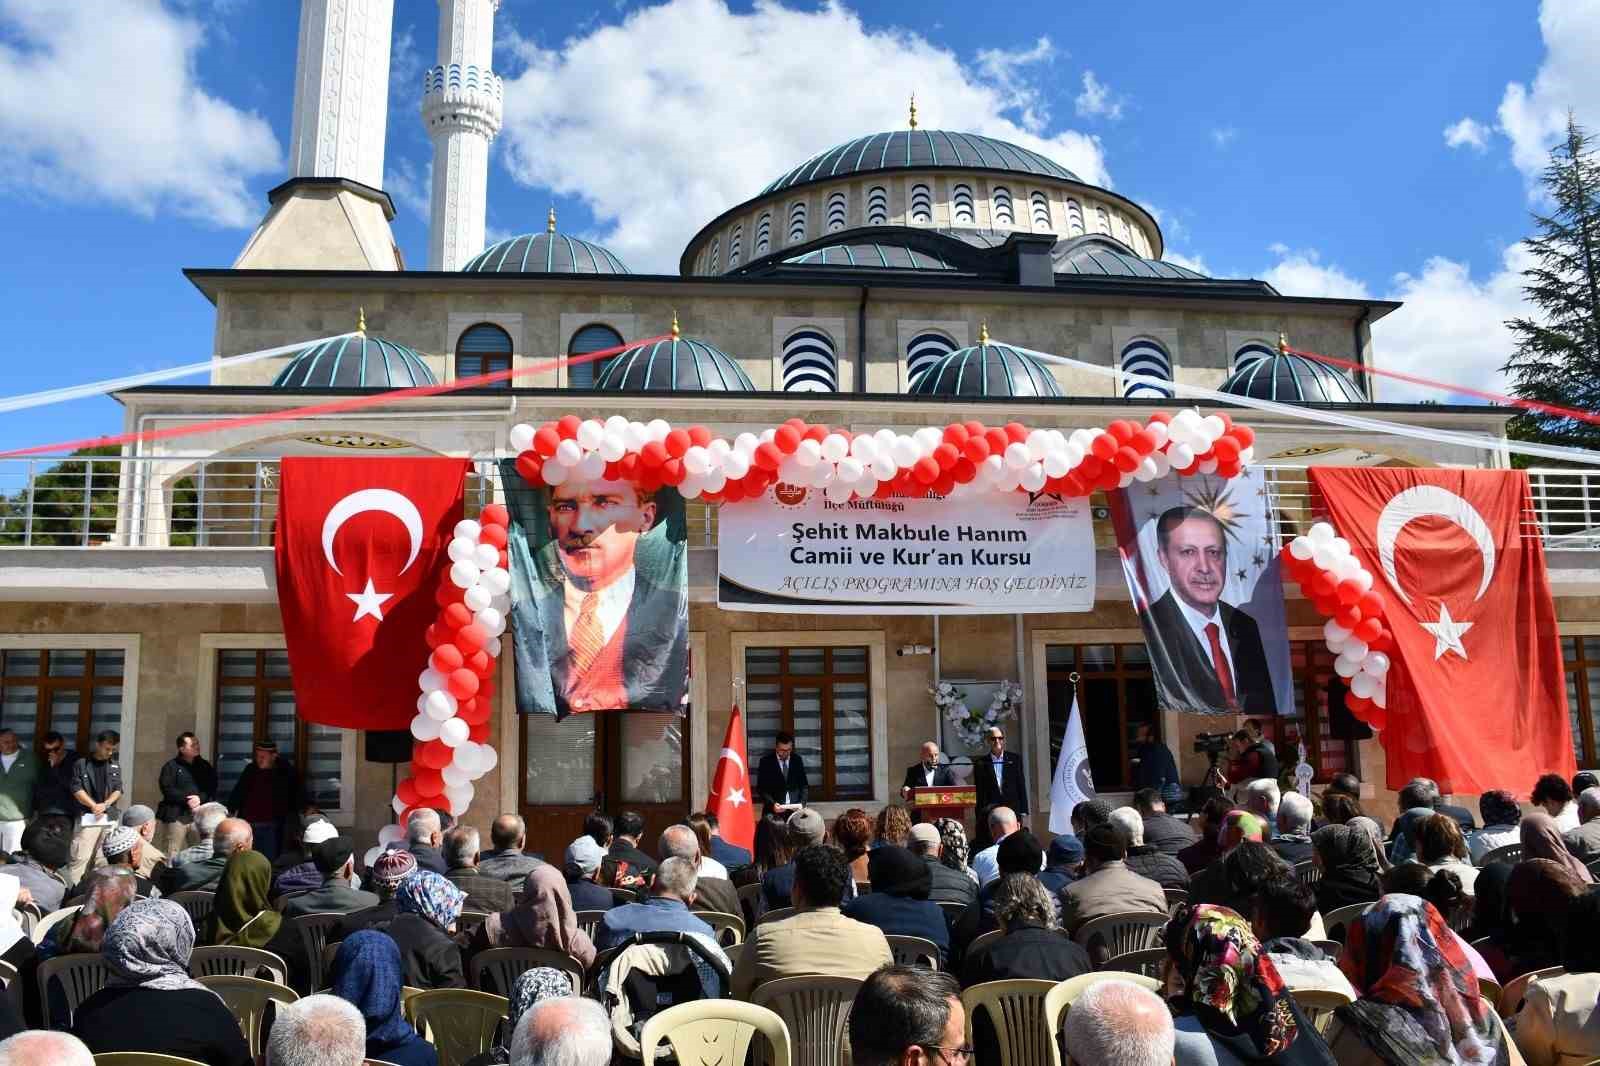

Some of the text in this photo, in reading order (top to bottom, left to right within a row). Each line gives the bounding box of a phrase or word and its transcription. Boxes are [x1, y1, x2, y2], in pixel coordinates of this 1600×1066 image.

[792, 522, 1028, 543] Şehit Makbule Hanım
[790, 547, 853, 565] Camii
[860, 551, 885, 565] ve
[971, 548, 1032, 566] Kursu
[778, 573, 1088, 594] AÇILIŞ PROGRAMINA HOŞ GELDİNİZ
